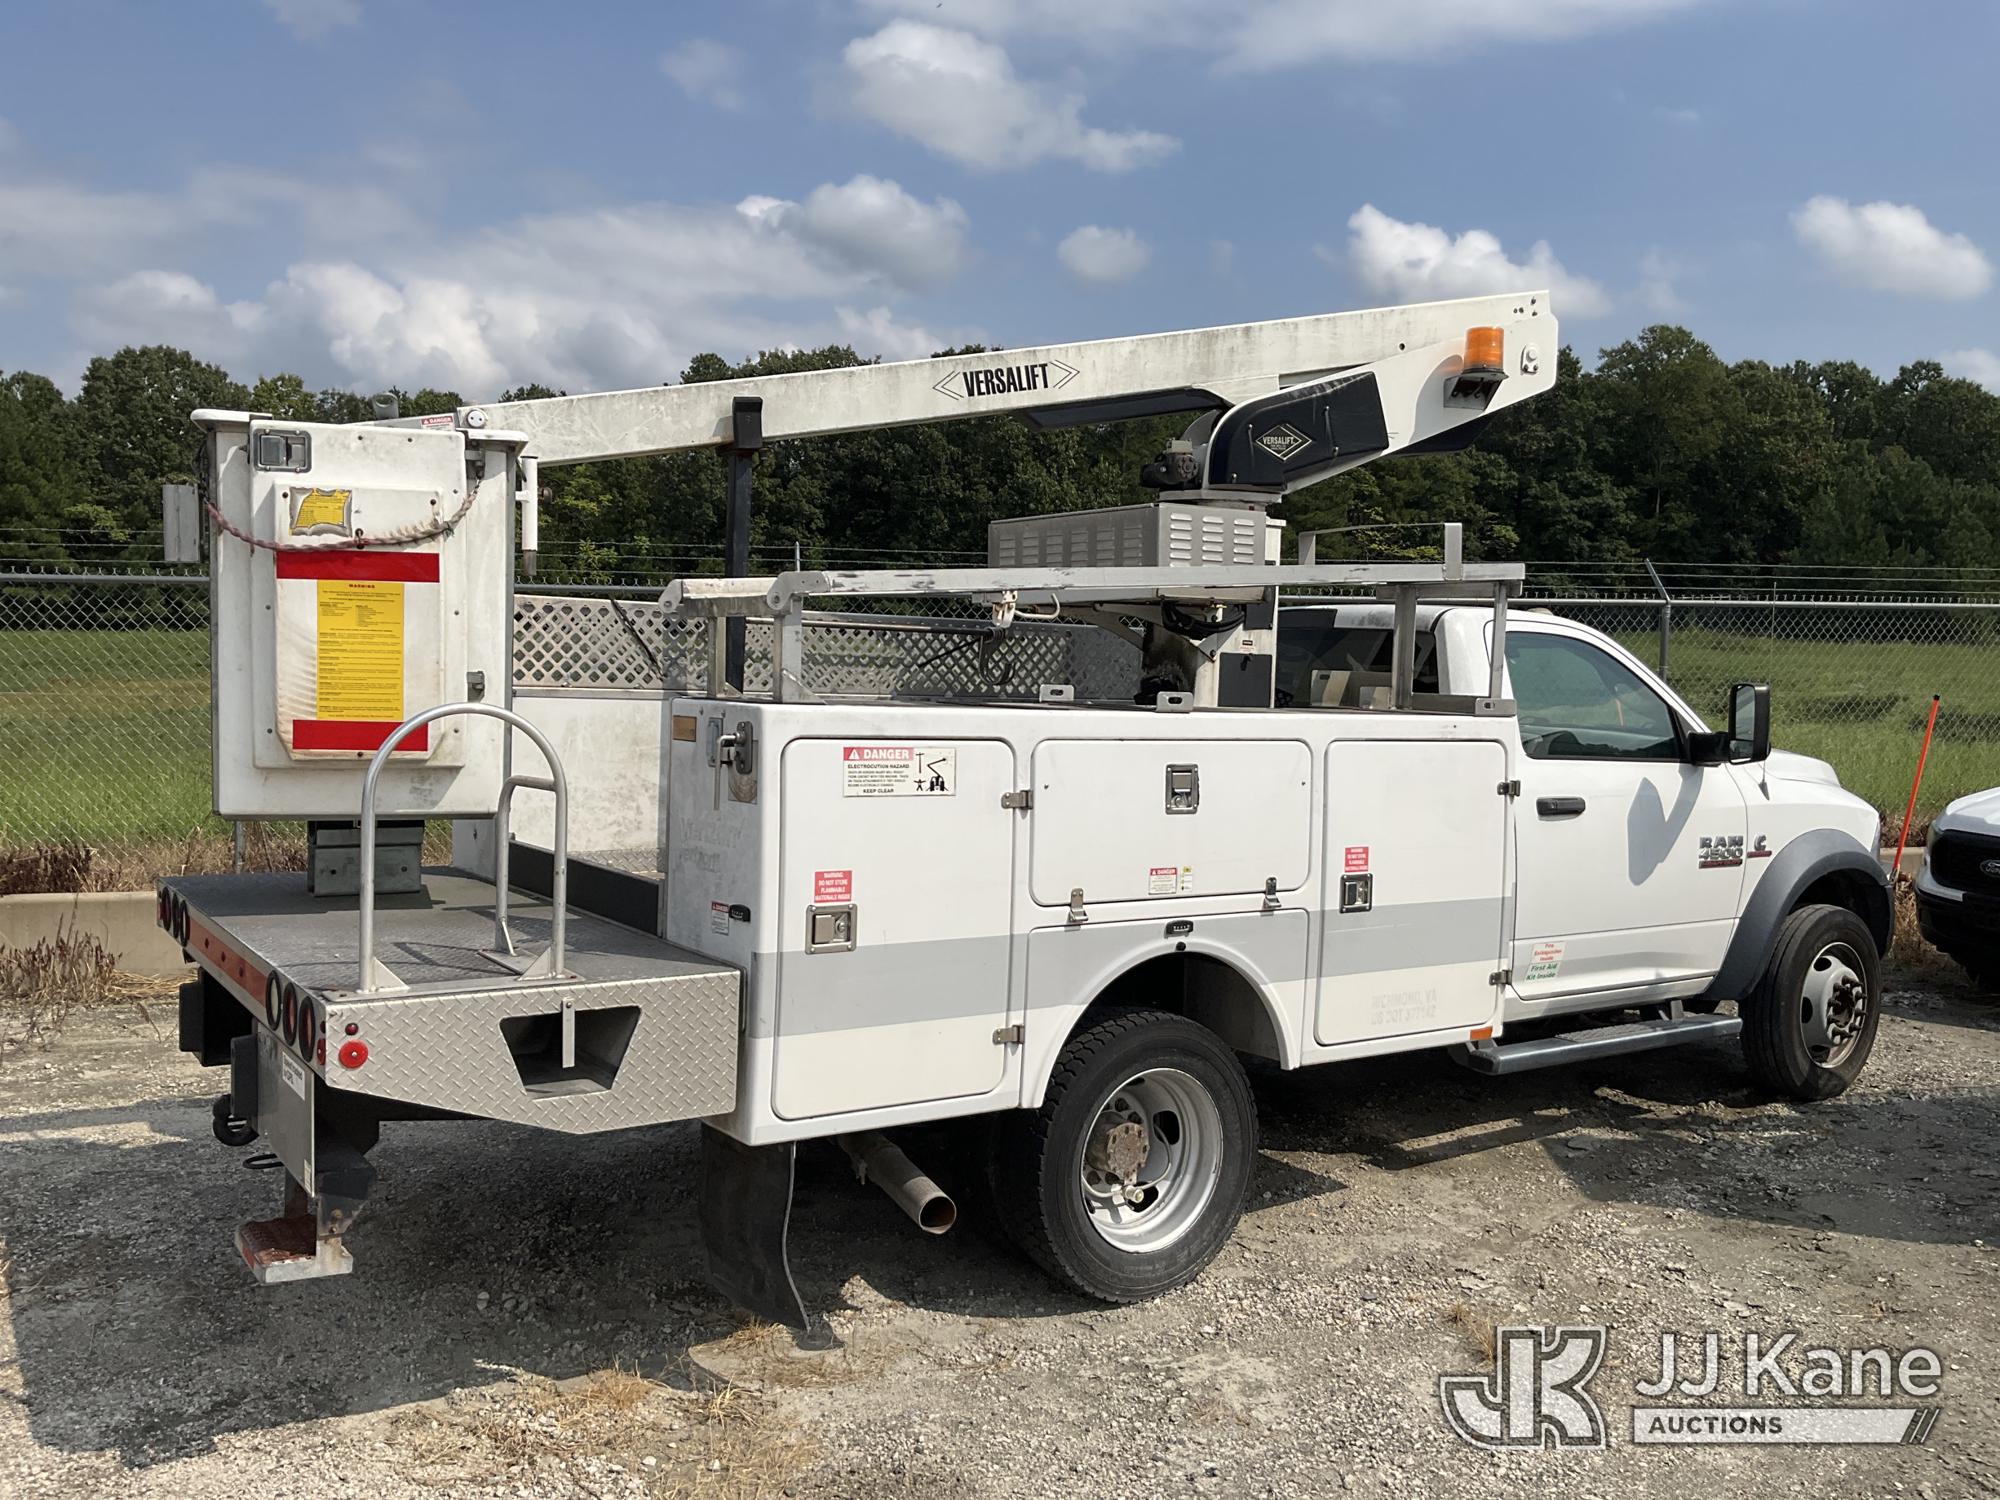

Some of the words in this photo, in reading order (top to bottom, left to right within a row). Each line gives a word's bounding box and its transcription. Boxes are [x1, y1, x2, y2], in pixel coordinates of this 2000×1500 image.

[962, 363, 1048, 397] VERSALIFT
[1263, 436, 1294, 445] VERSALIFT
[863, 749, 909, 760] DANGER
[1699, 835, 1743, 849] RAM
[1698, 846, 1743, 860] 4500
